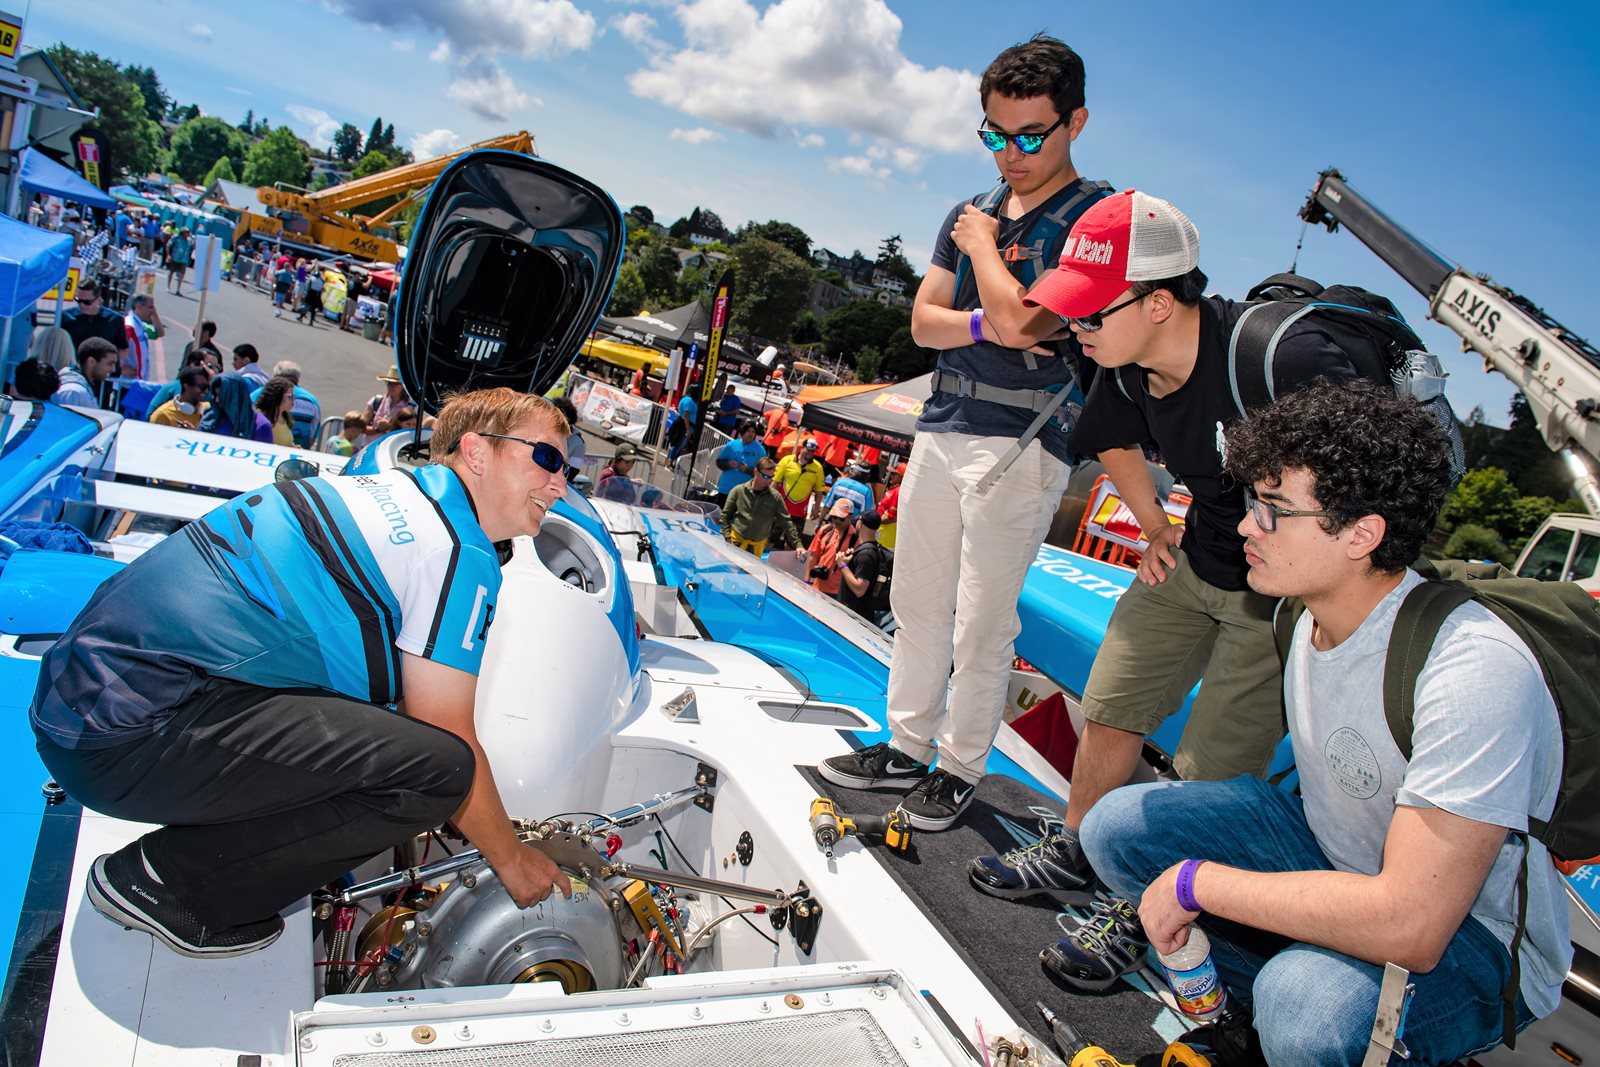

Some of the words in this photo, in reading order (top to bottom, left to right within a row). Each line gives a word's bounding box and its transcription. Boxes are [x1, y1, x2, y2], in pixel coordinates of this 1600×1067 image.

[1454, 287, 1502, 334] AXIS
[837, 421, 863, 438] Doing
[865, 429, 881, 442] The
[882, 434, 907, 450] Right
[175, 437, 279, 469] Bank
[1178, 973, 1214, 995] Snapple
